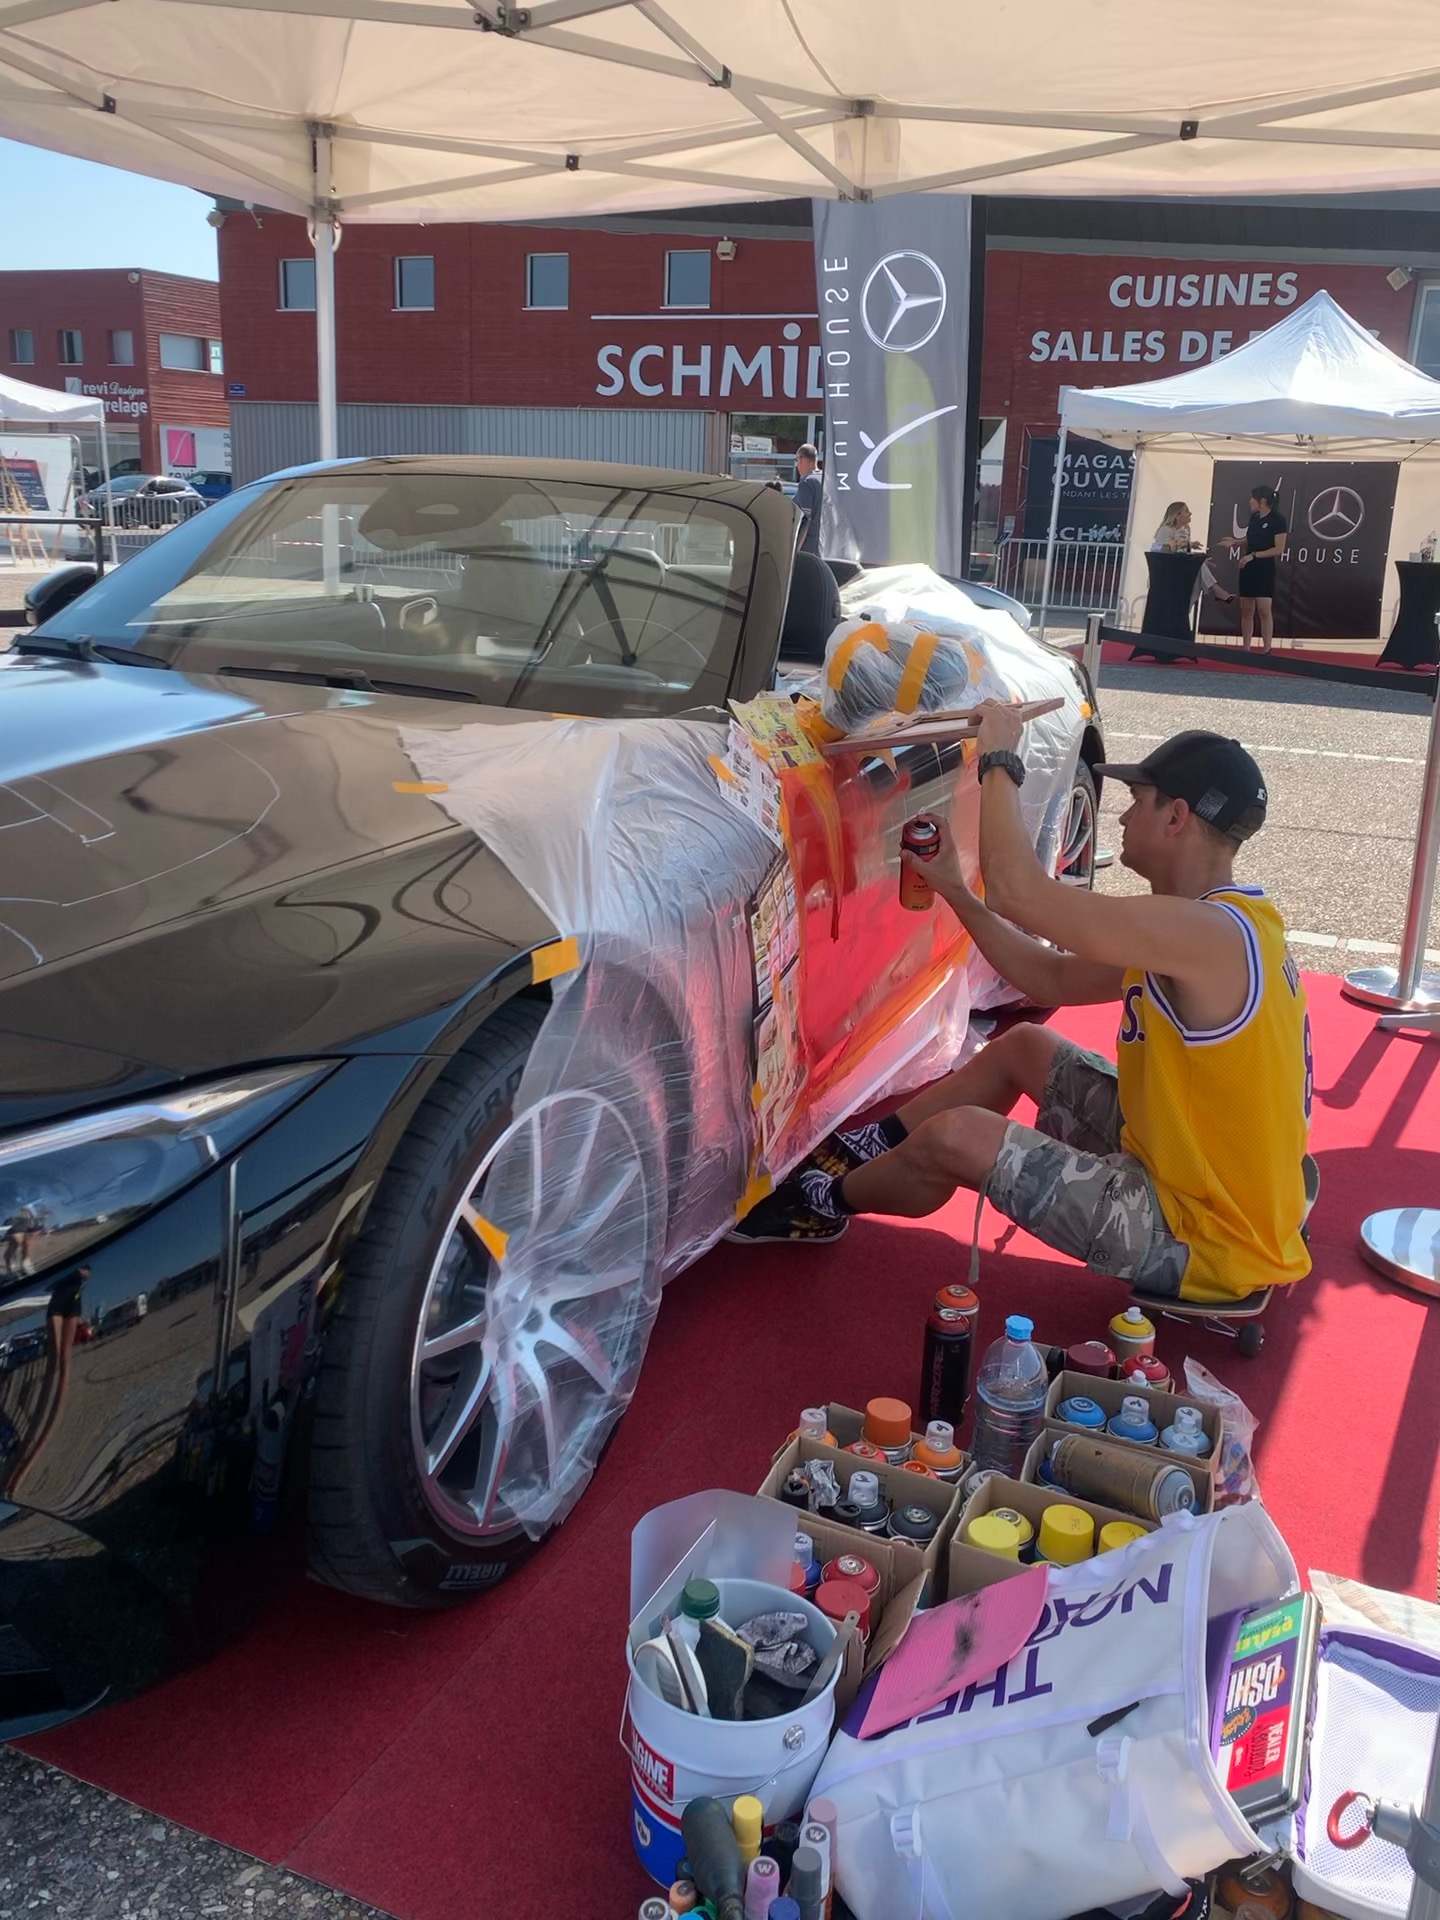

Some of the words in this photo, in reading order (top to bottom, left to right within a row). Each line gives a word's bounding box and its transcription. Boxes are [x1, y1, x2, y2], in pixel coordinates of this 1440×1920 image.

[1109, 272, 1299, 308] CUISINES
[1028, 330, 1167, 362] SALLES
[1179, 331, 1234, 362] DE
